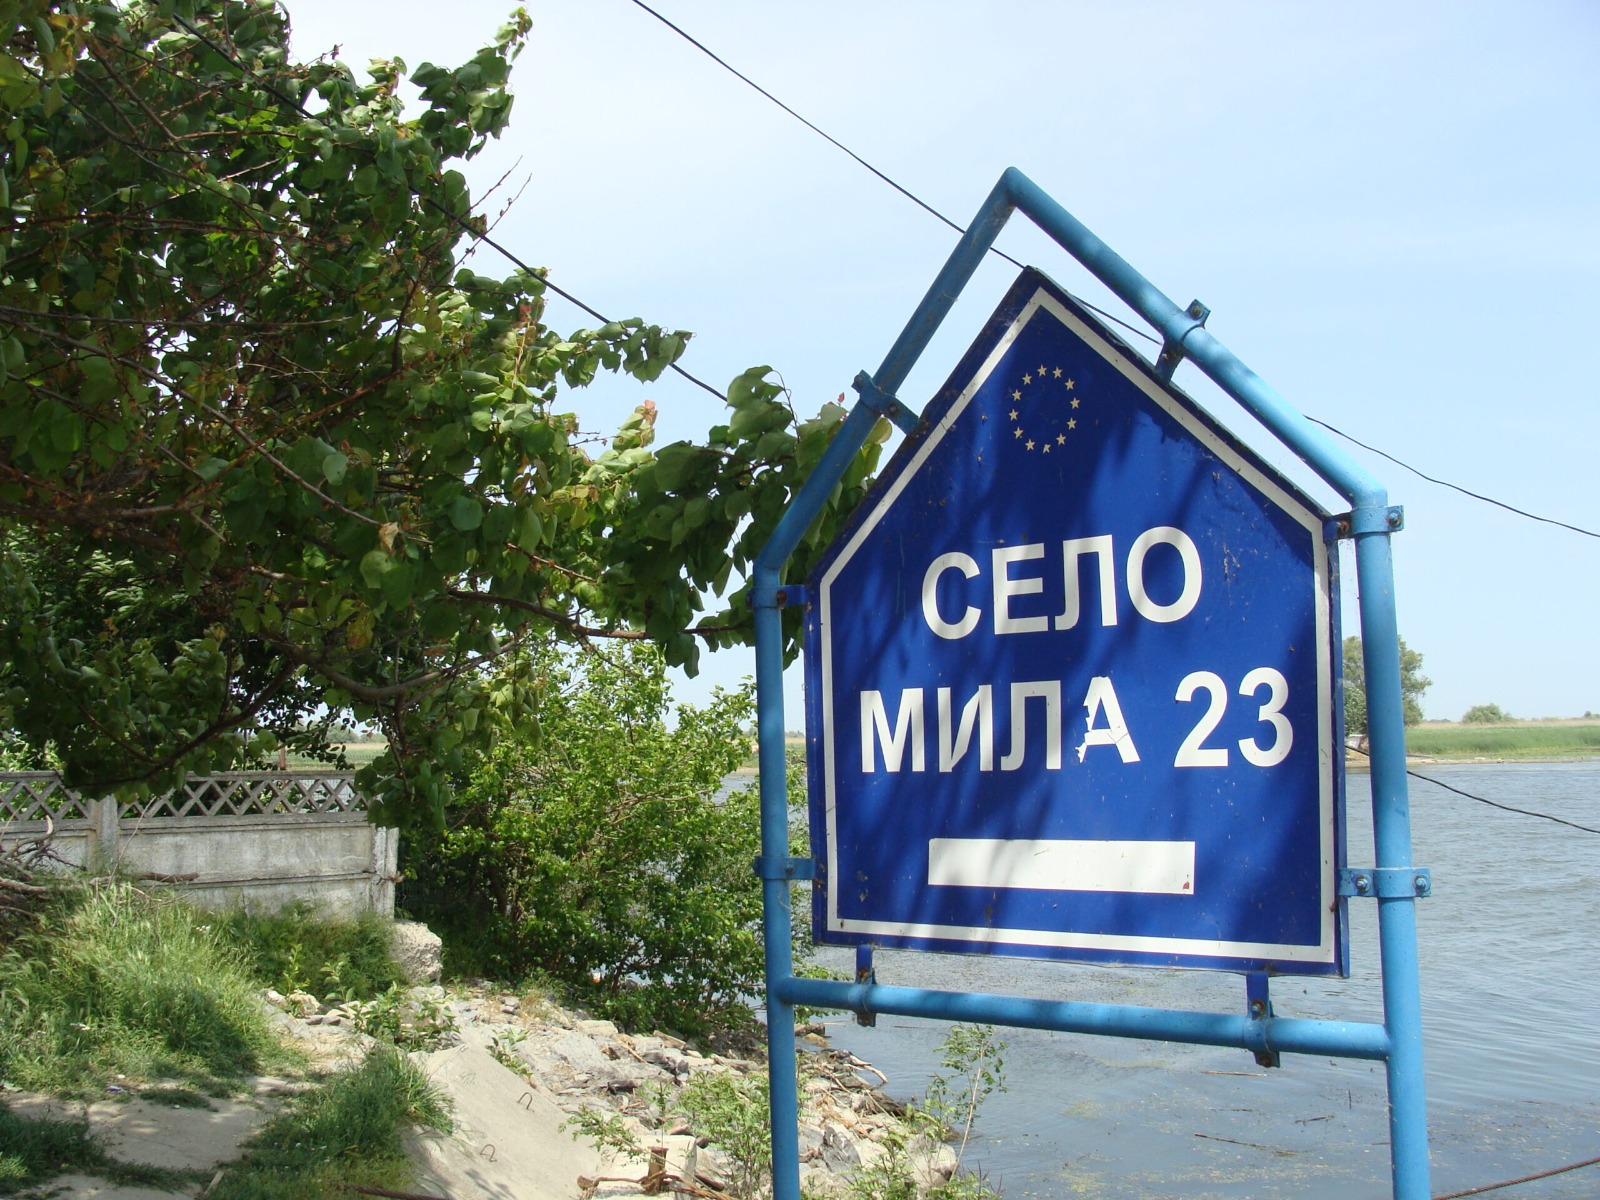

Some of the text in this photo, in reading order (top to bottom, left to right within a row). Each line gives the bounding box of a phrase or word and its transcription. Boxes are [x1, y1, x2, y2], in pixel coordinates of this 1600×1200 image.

[922, 526, 1203, 640] СЕЛО
[860, 667, 1294, 773] МИЛА 23
